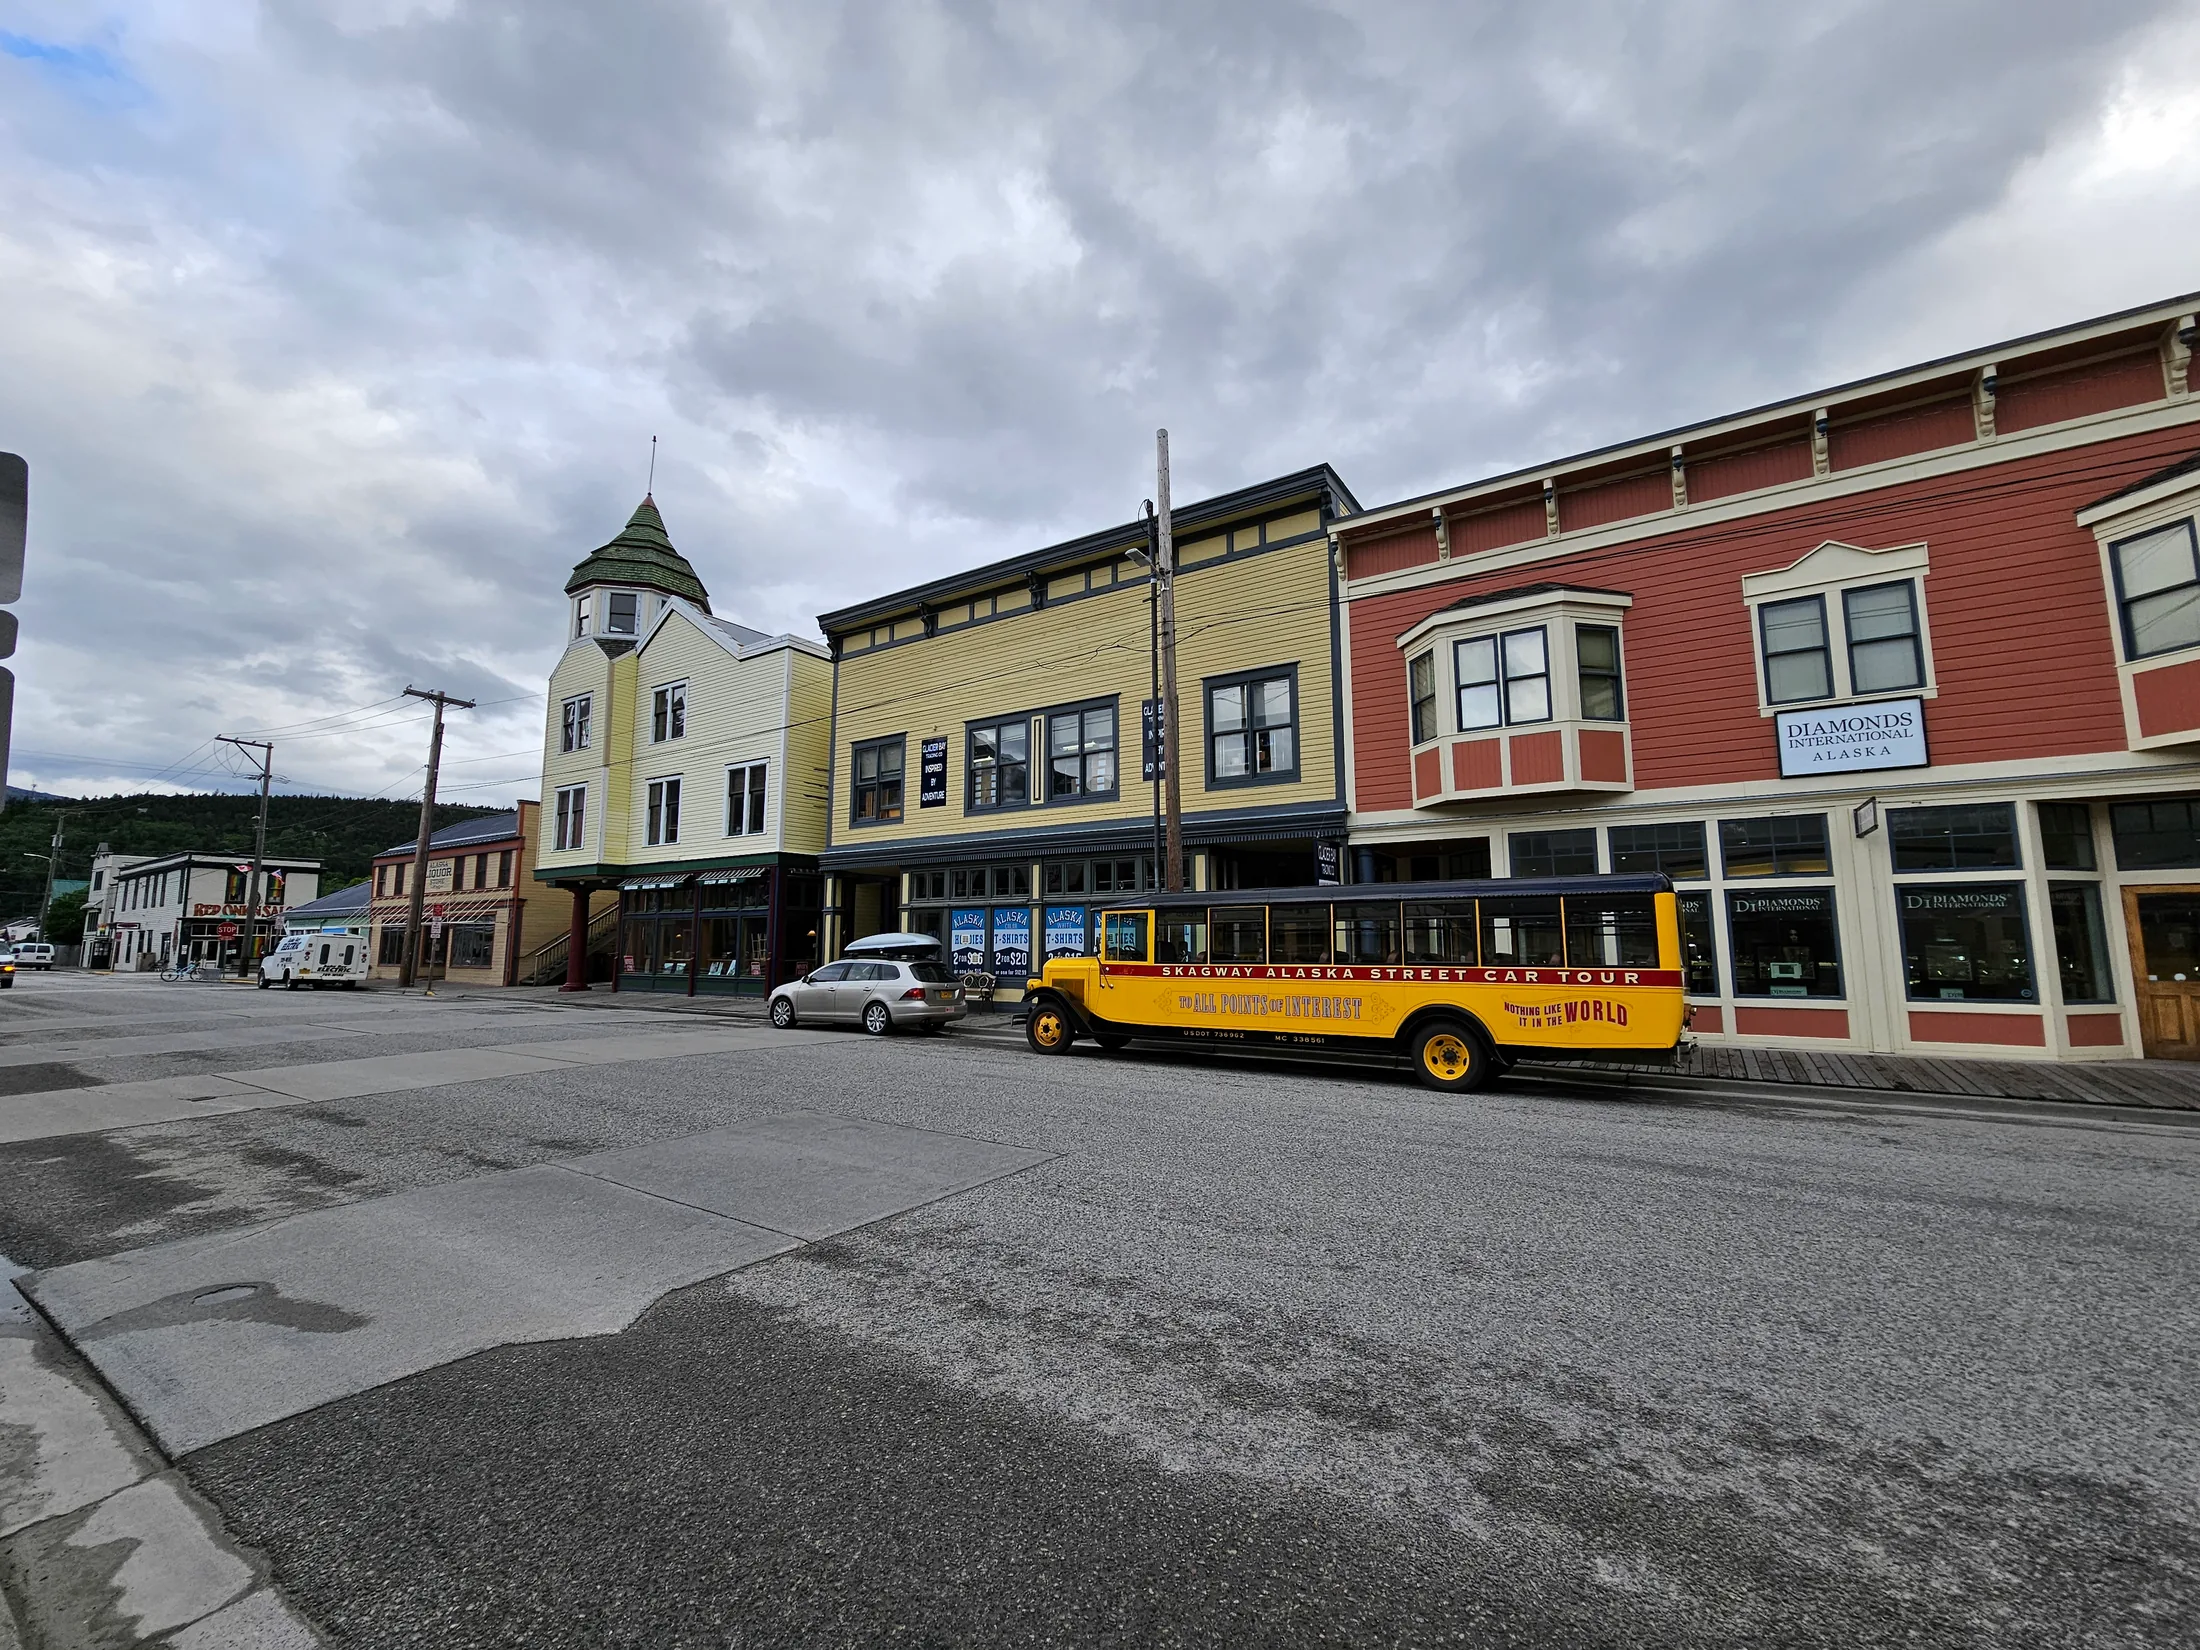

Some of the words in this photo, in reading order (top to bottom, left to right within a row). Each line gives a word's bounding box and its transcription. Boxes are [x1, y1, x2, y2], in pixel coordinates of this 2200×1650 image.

[1787, 712, 1913, 738] DIAMONDS
[1789, 729, 1913, 748] INTERNATIONAL
[922, 743, 938, 753] GLACIER
[939, 742, 947, 750] BAY
[1813, 746, 1891, 762] ALASKA
[925, 763, 943, 773] INSPIRED
[930, 778, 937, 787] BY
[922, 791, 945, 801] ADVENTURE
[427, 868, 453, 879] IQUOR
[1758, 898, 1820, 907] DIAMONDS
[1933, 893, 2008, 904] DIAMONDS
[193, 903, 221, 917] RED
[953, 913, 984, 929] ALASKA
[995, 911, 1028, 927] ALASKA
[1047, 910, 1083, 926] ALASKA
[995, 933, 1028, 944] T-SHIRTS
[1046, 933, 1083, 944] T-SHIRTS
[953, 952, 959, 965] 2
[995, 952, 1001, 965] 2
[1010, 952, 1027, 965] $20
[1162, 966, 1253, 977] SKAGWAY
[1266, 967, 1354, 979] ALASKA
[1370, 968, 1467, 981] STREET
[1484, 970, 1539, 982] CAR
[1557, 971, 1640, 984] TOUR
[1179, 996, 1192, 1009] TO
[1193, 992, 1217, 1013] ALL
[1221, 993, 1268, 1015] POINTS
[1285, 995, 1363, 1020] INTEREST
[1504, 1001, 1541, 1016] NOTHING
[1543, 1001, 1562, 1015] LIKE
[1564, 999, 1628, 1027] WORLD
[1519, 1017, 1527, 1027] IT
[1532, 1017, 1542, 1028] IN
[1546, 1016, 1562, 1027] THE
